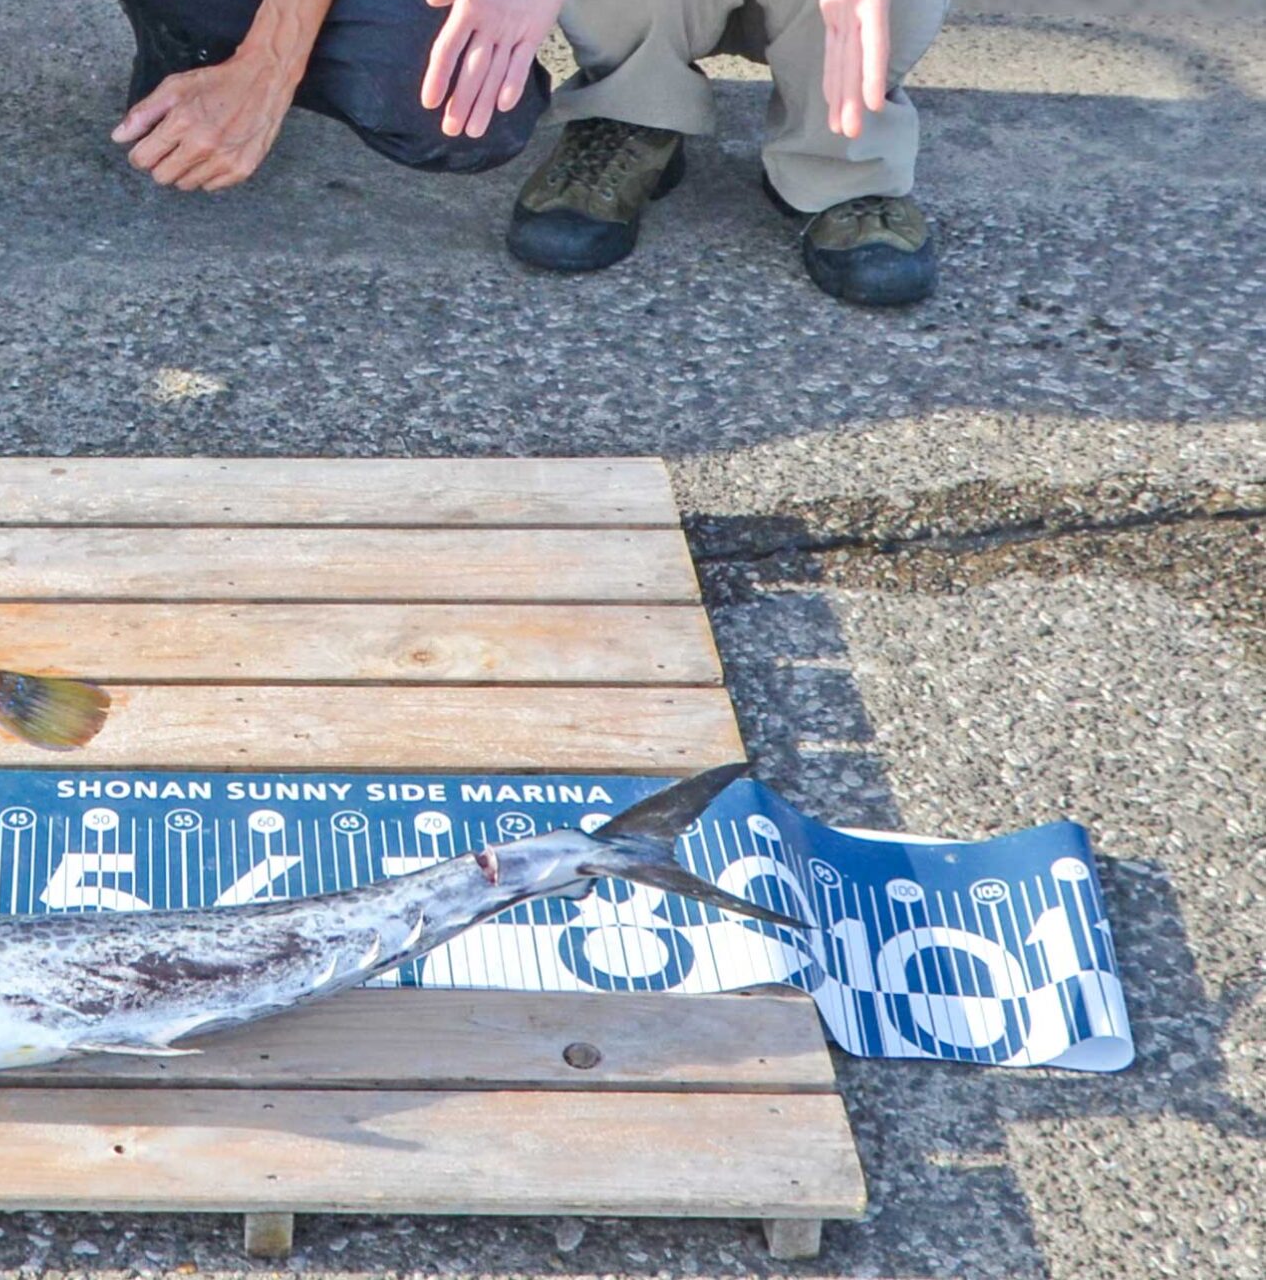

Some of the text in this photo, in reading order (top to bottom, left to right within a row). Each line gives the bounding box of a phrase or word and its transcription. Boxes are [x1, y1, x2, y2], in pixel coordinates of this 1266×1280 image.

[57, 780, 613, 805] SHONAN SUNNY SIDE MARINA
[9, 812, 28, 825] 45
[92, 814, 110, 825] 50
[174, 815, 194, 827] 55
[257, 816, 276, 827] 60
[339, 817, 360, 828] 65
[423, 818, 442, 829] 70
[505, 818, 526, 831] 75
[892, 884, 918, 897] 100
[976, 884, 1001, 899] 105
[827, 917, 1033, 1066] 10
